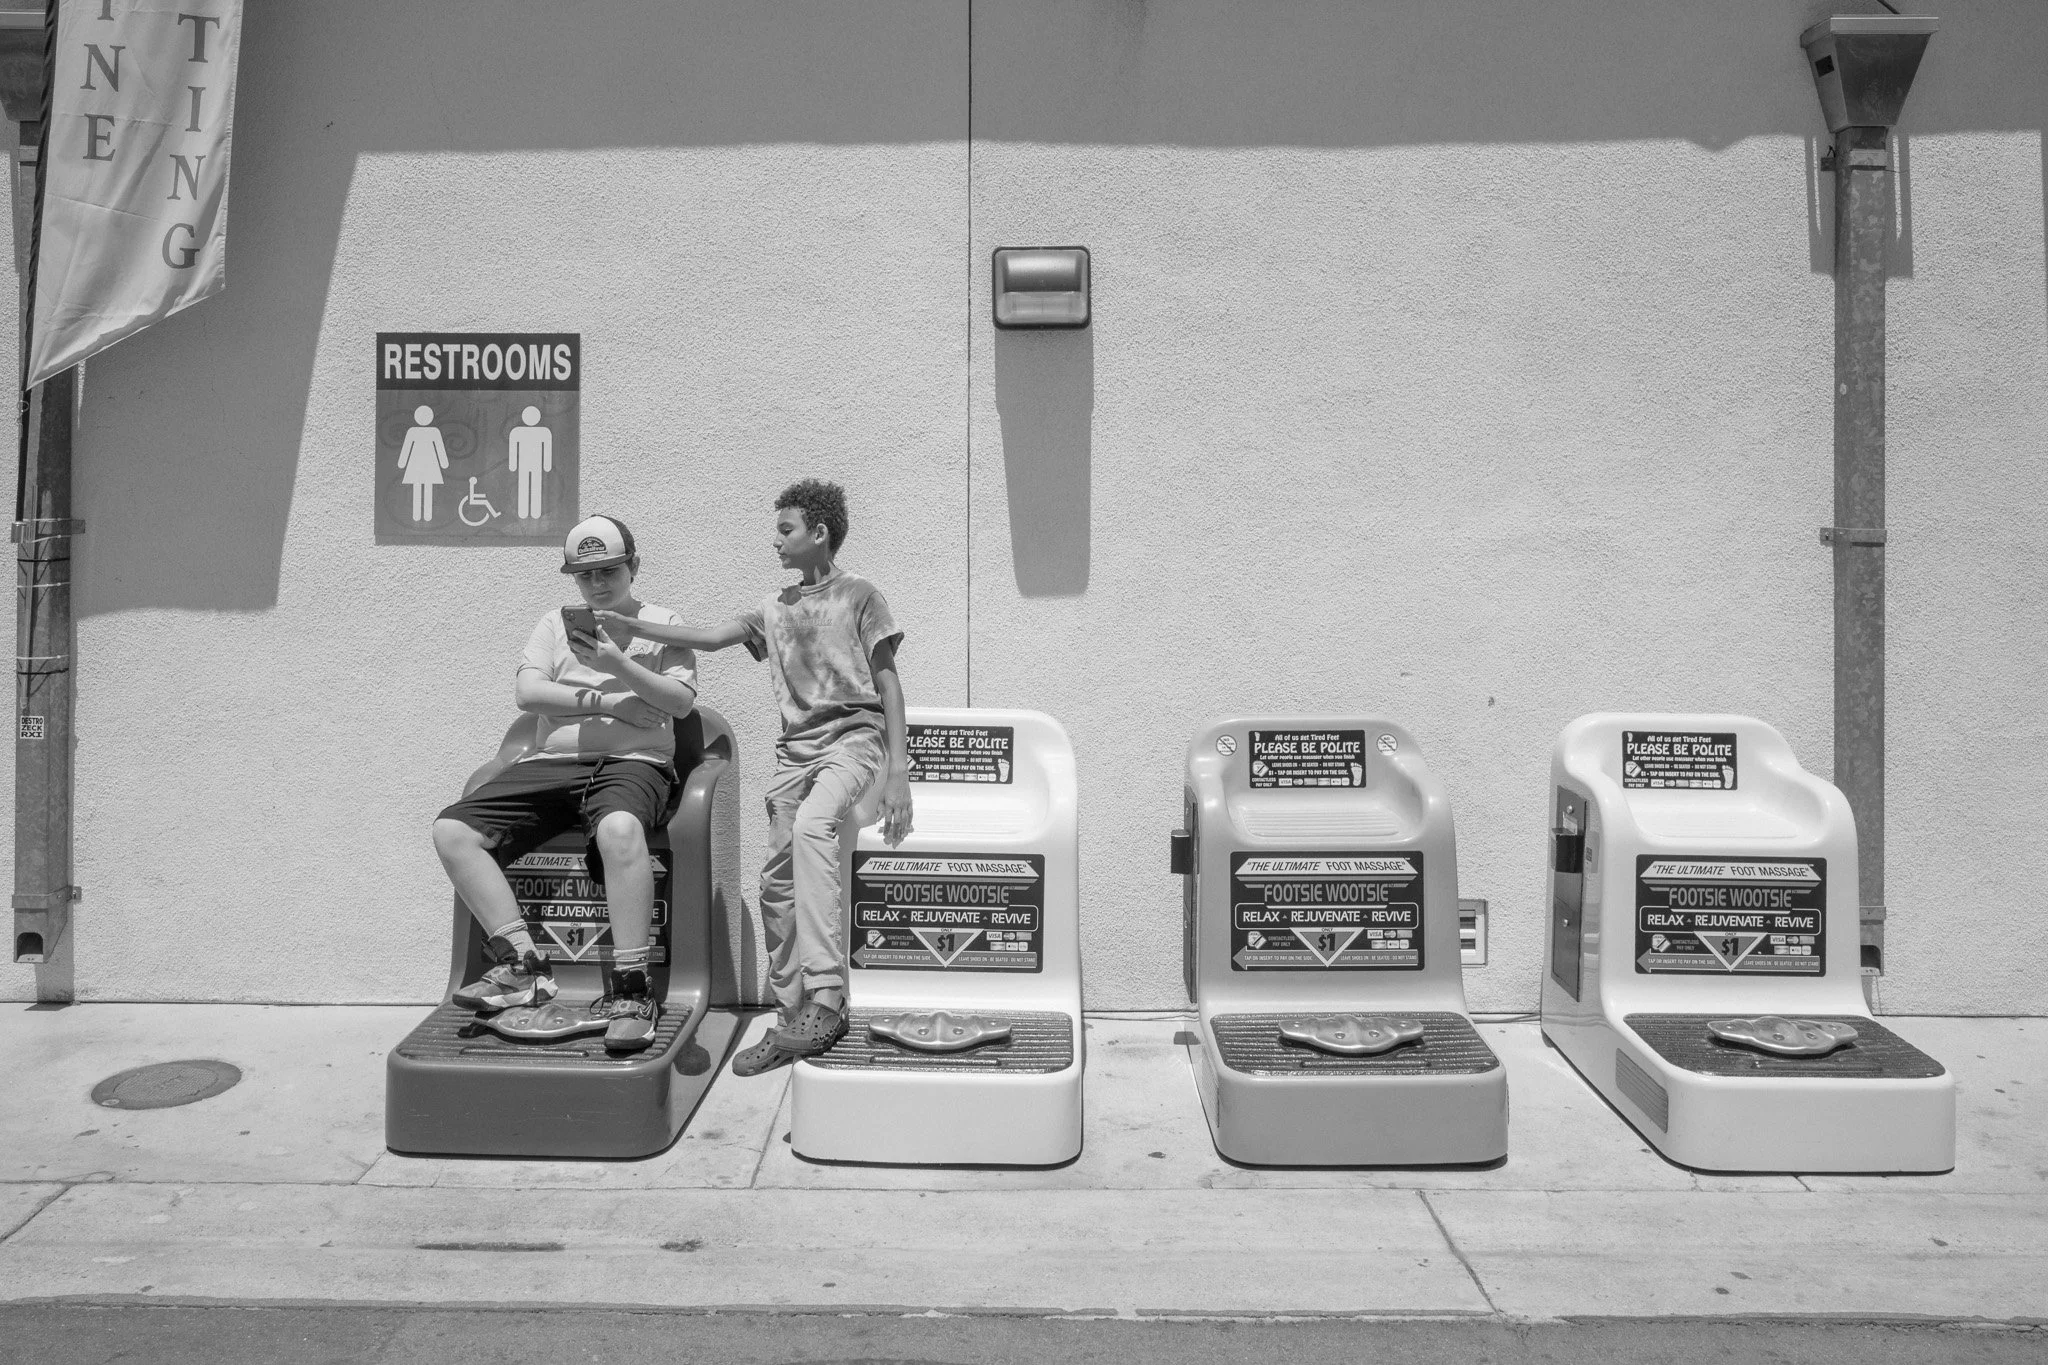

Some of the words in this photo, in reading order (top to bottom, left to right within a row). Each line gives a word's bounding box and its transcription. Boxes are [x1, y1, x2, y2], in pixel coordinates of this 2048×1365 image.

[384, 343, 572, 380] RESTROOMS
[950, 737, 964, 748] BE
[969, 738, 1008, 749] POLITE
[1254, 743, 1297, 753] PLEASE
[1302, 742, 1316, 753] BE
[1321, 742, 1360, 753] POLITE
[1627, 744, 1669, 754] PLEASE
[1674, 744, 1688, 755] BE
[1693, 744, 1732, 755] POLITE
[524, 856, 572, 866] ULTIMATE
[894, 862, 942, 872] ULTIMATE
[948, 862, 972, 873] FOOT
[1272, 862, 1320, 871] ULTIMATE
[1326, 862, 1352, 871] FOOT
[1677, 866, 1725, 875] ULTIMATE
[1731, 866, 1757, 876] FOOT
[516, 878, 573, 897] FOOTSIE
[884, 884, 943, 902] FOOTSIE
[947, 885, 1010, 904] WOOTSIE
[1264, 884, 1323, 902] FOOTSIE
[1326, 884, 1389, 902] WOOTSIE
[1669, 888, 1726, 906] FOOTSIE
[1730, 889, 1792, 908] WOOTSIE
[541, 906, 609, 917] REJUVENATE
[863, 911, 900, 922] RELAX
[911, 911, 980, 923] REJUVENATE
[991, 913, 1031, 924] REVIVE
[1243, 911, 1280, 922] RELAX
[1291, 911, 1360, 922] REJUVENATE
[1372, 911, 1411, 922] REVIVE
[1648, 914, 1684, 925] RELAX
[1695, 916, 1764, 927] REJUVENATE
[1775, 917, 1813, 928] REVIVE
[566, 928, 584, 946] $1
[937, 934, 955, 952] $1
[1318, 934, 1336, 951] $1
[1721, 938, 1739, 956] $1
